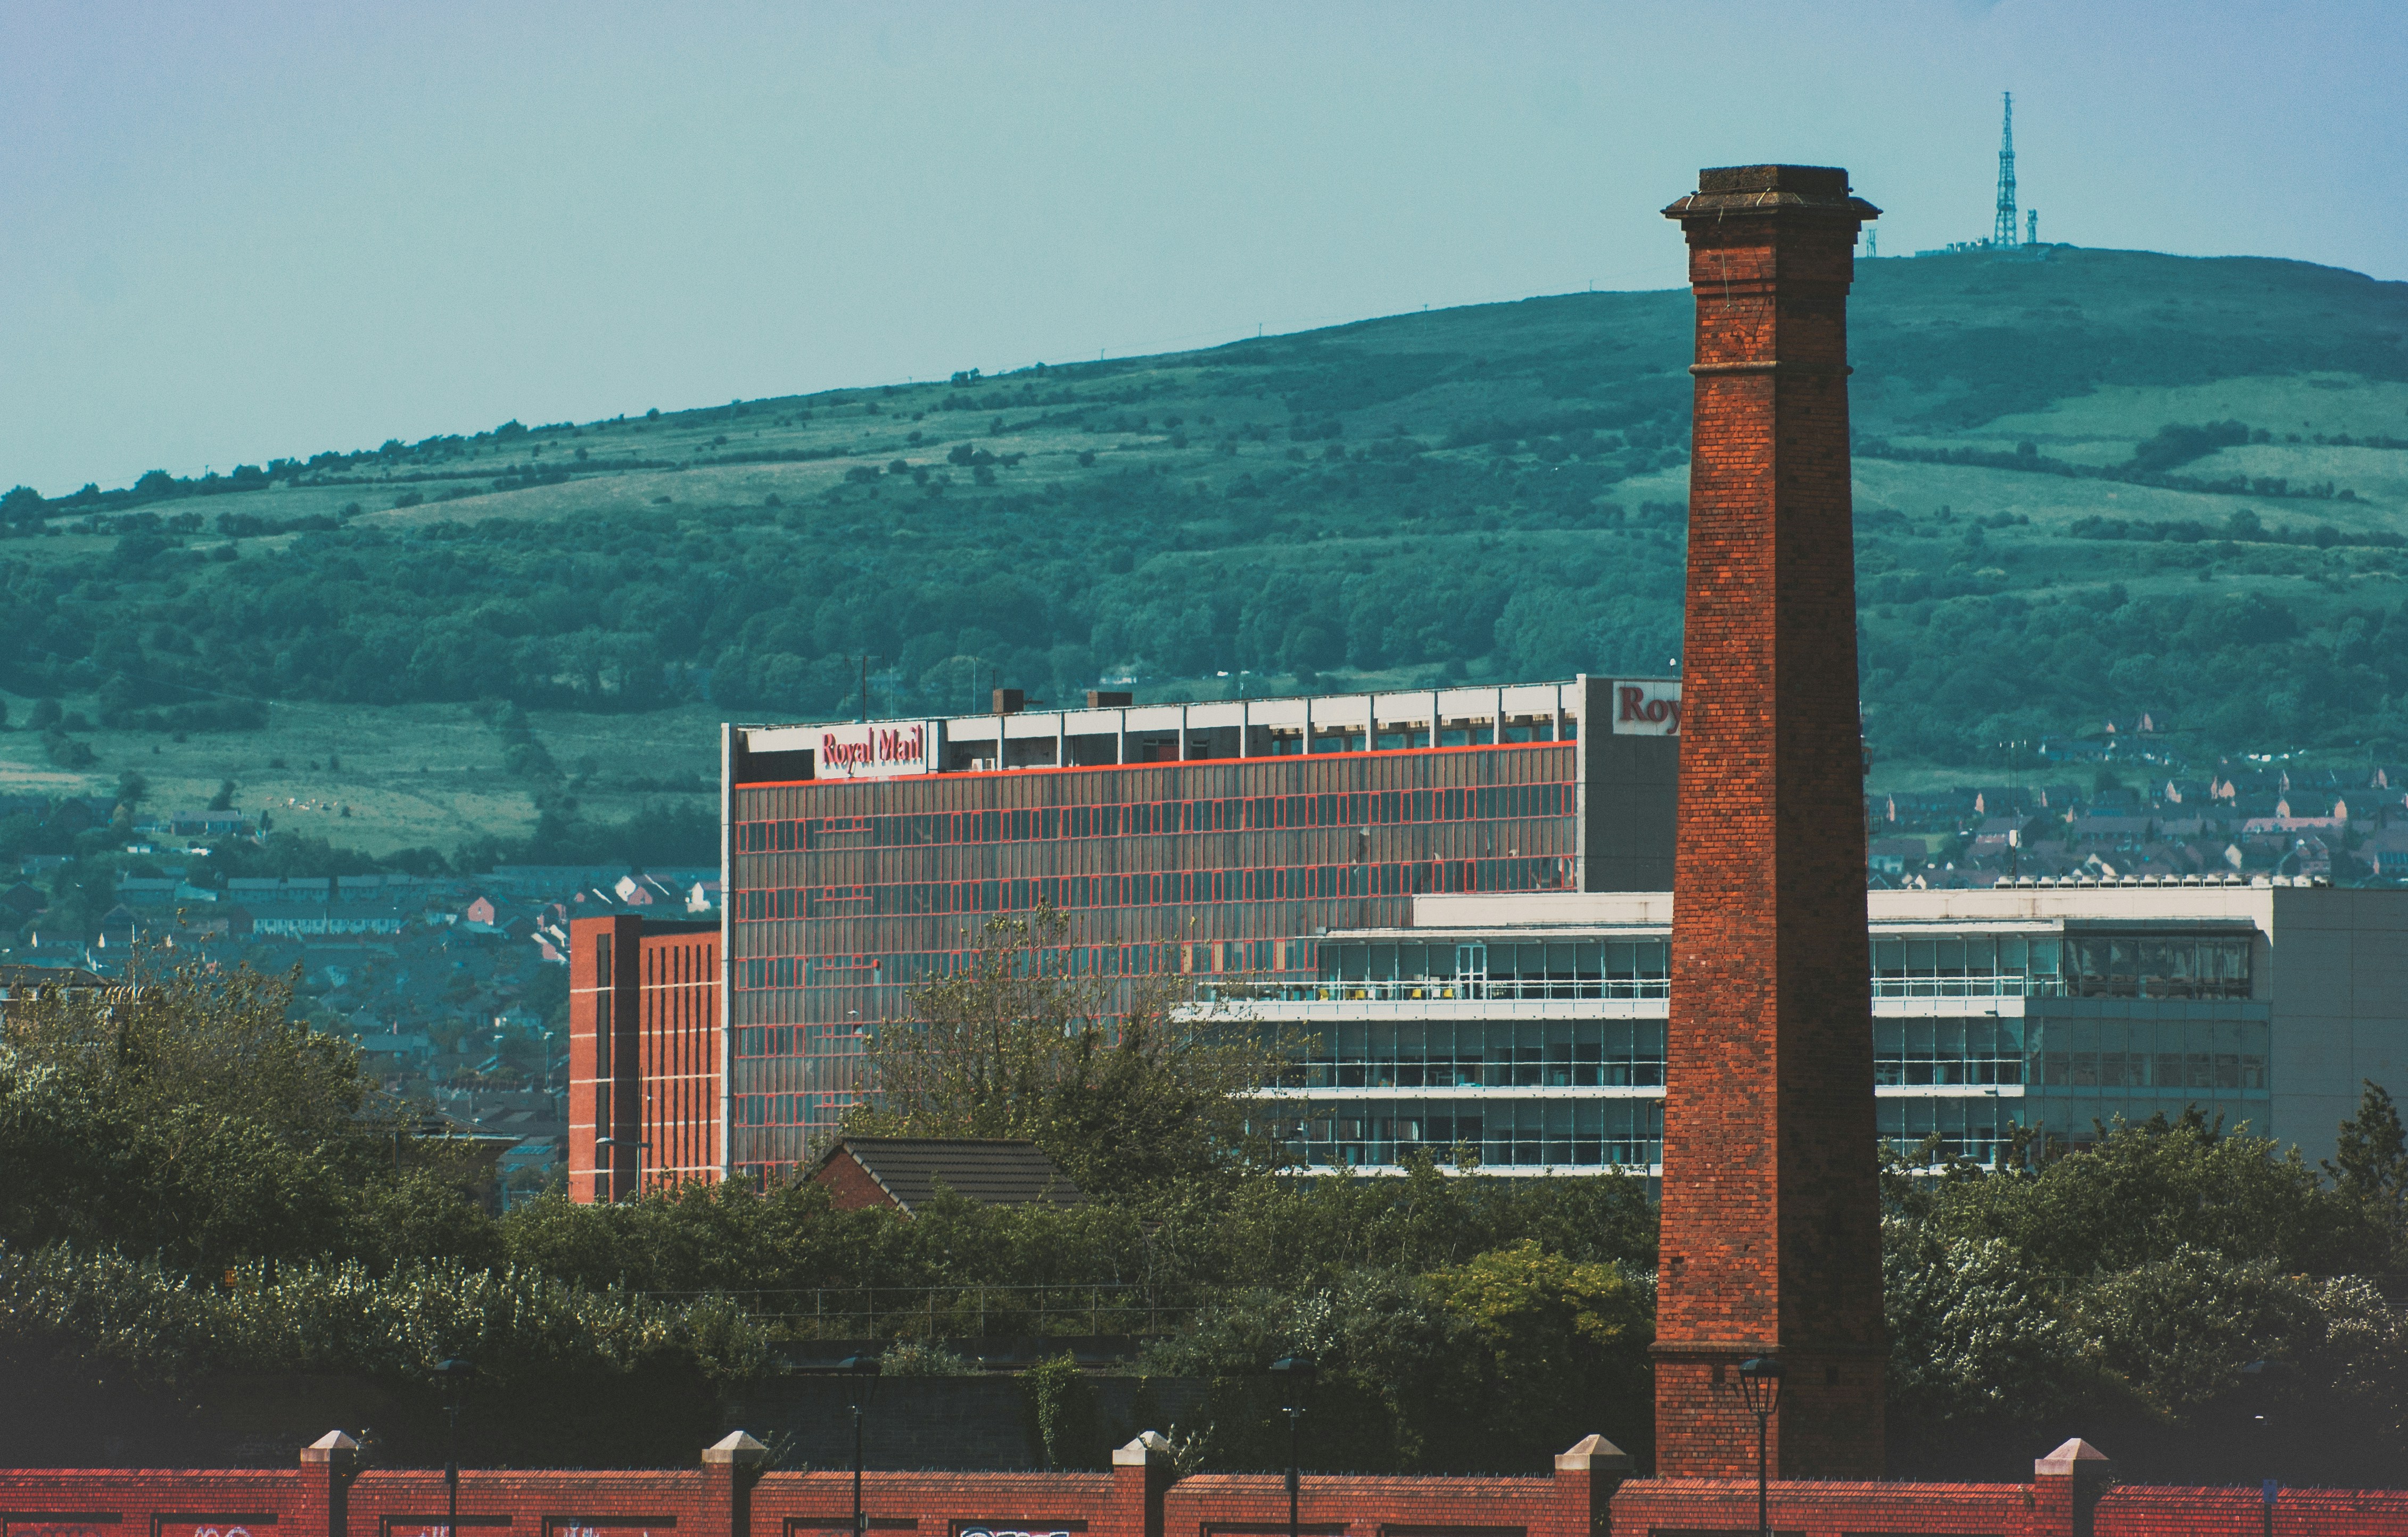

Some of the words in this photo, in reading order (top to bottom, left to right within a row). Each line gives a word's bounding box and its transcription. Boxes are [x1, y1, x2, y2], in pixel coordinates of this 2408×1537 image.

[1619, 686, 1681, 734] Roy
[822, 726, 875, 774] Royal
[879, 724, 923, 762] Mail
